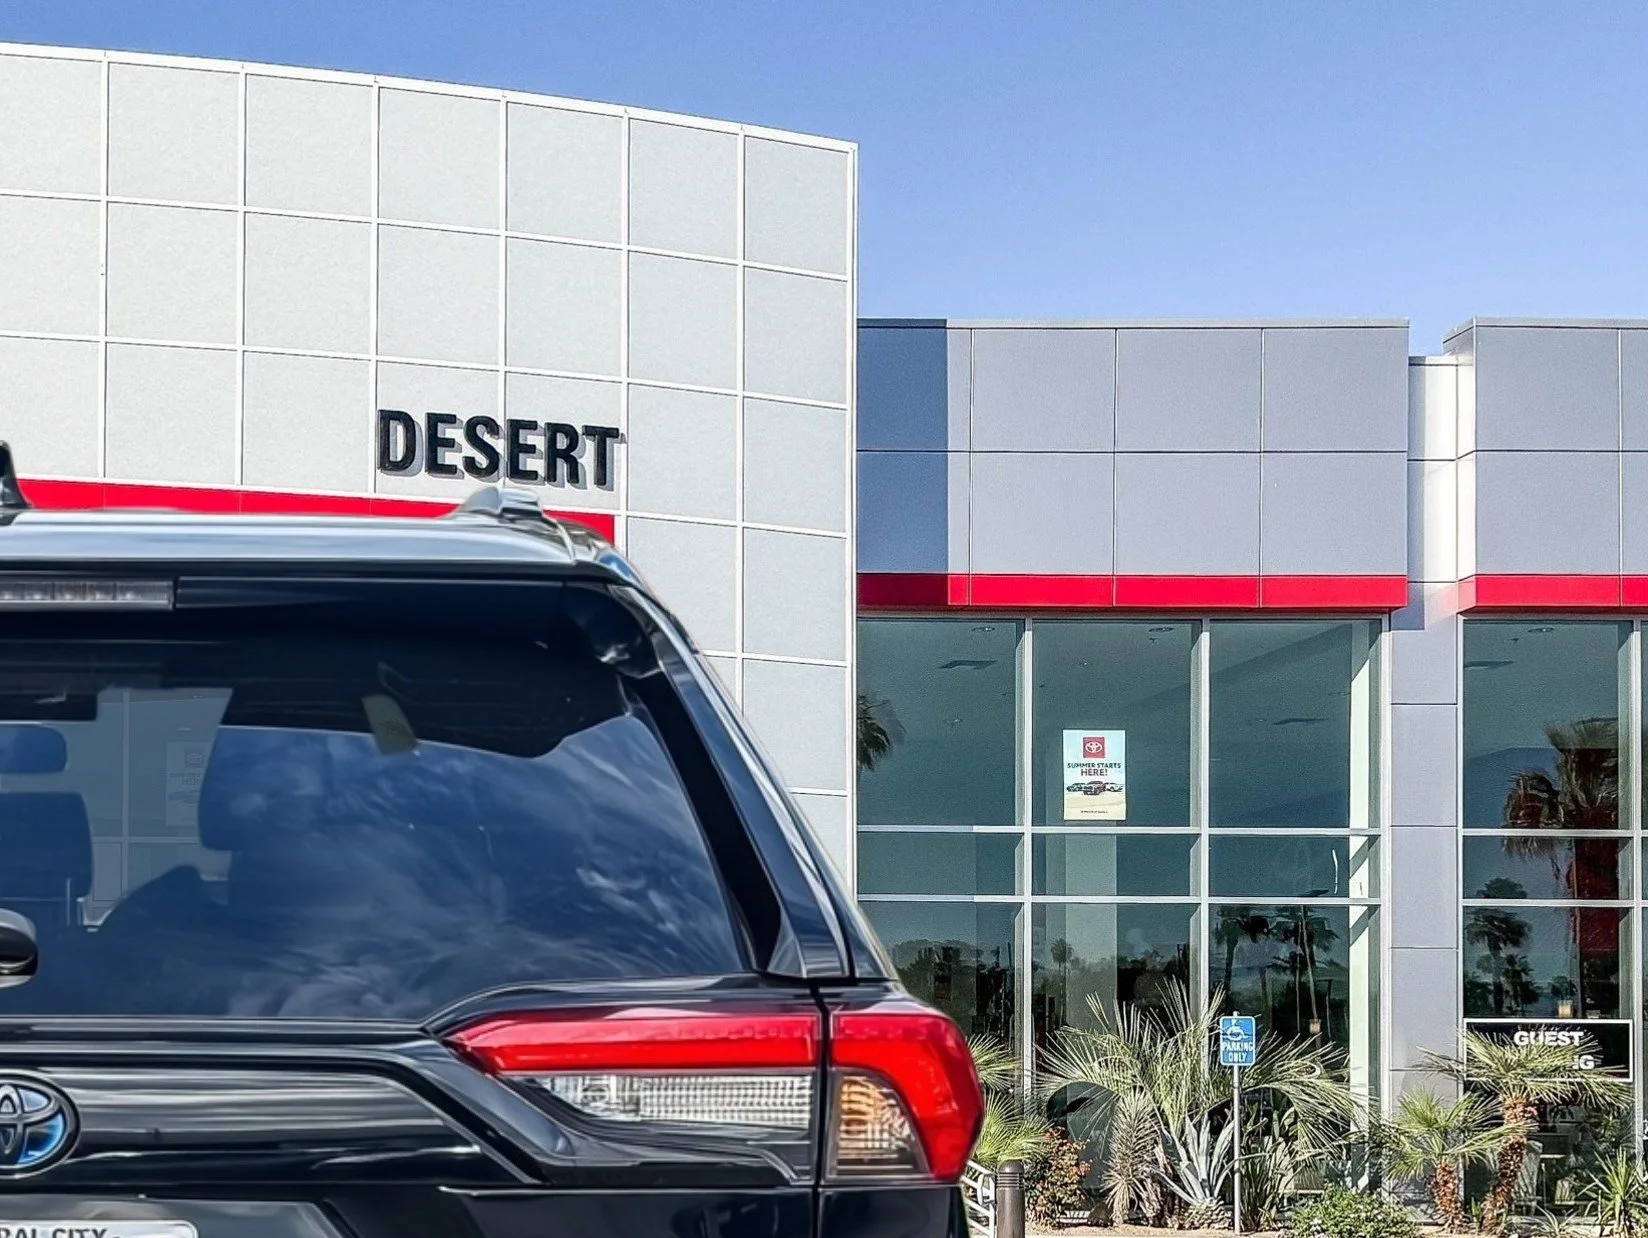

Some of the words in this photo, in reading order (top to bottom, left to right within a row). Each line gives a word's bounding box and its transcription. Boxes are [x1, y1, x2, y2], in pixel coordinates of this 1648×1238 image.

[376, 409, 620, 487] DESERT
[1080, 768, 1108, 776] HERE!
[1513, 1030, 1584, 1047] GUEST
[1222, 1041, 1254, 1052] PARKING
[1228, 1052, 1247, 1062] ONLY
